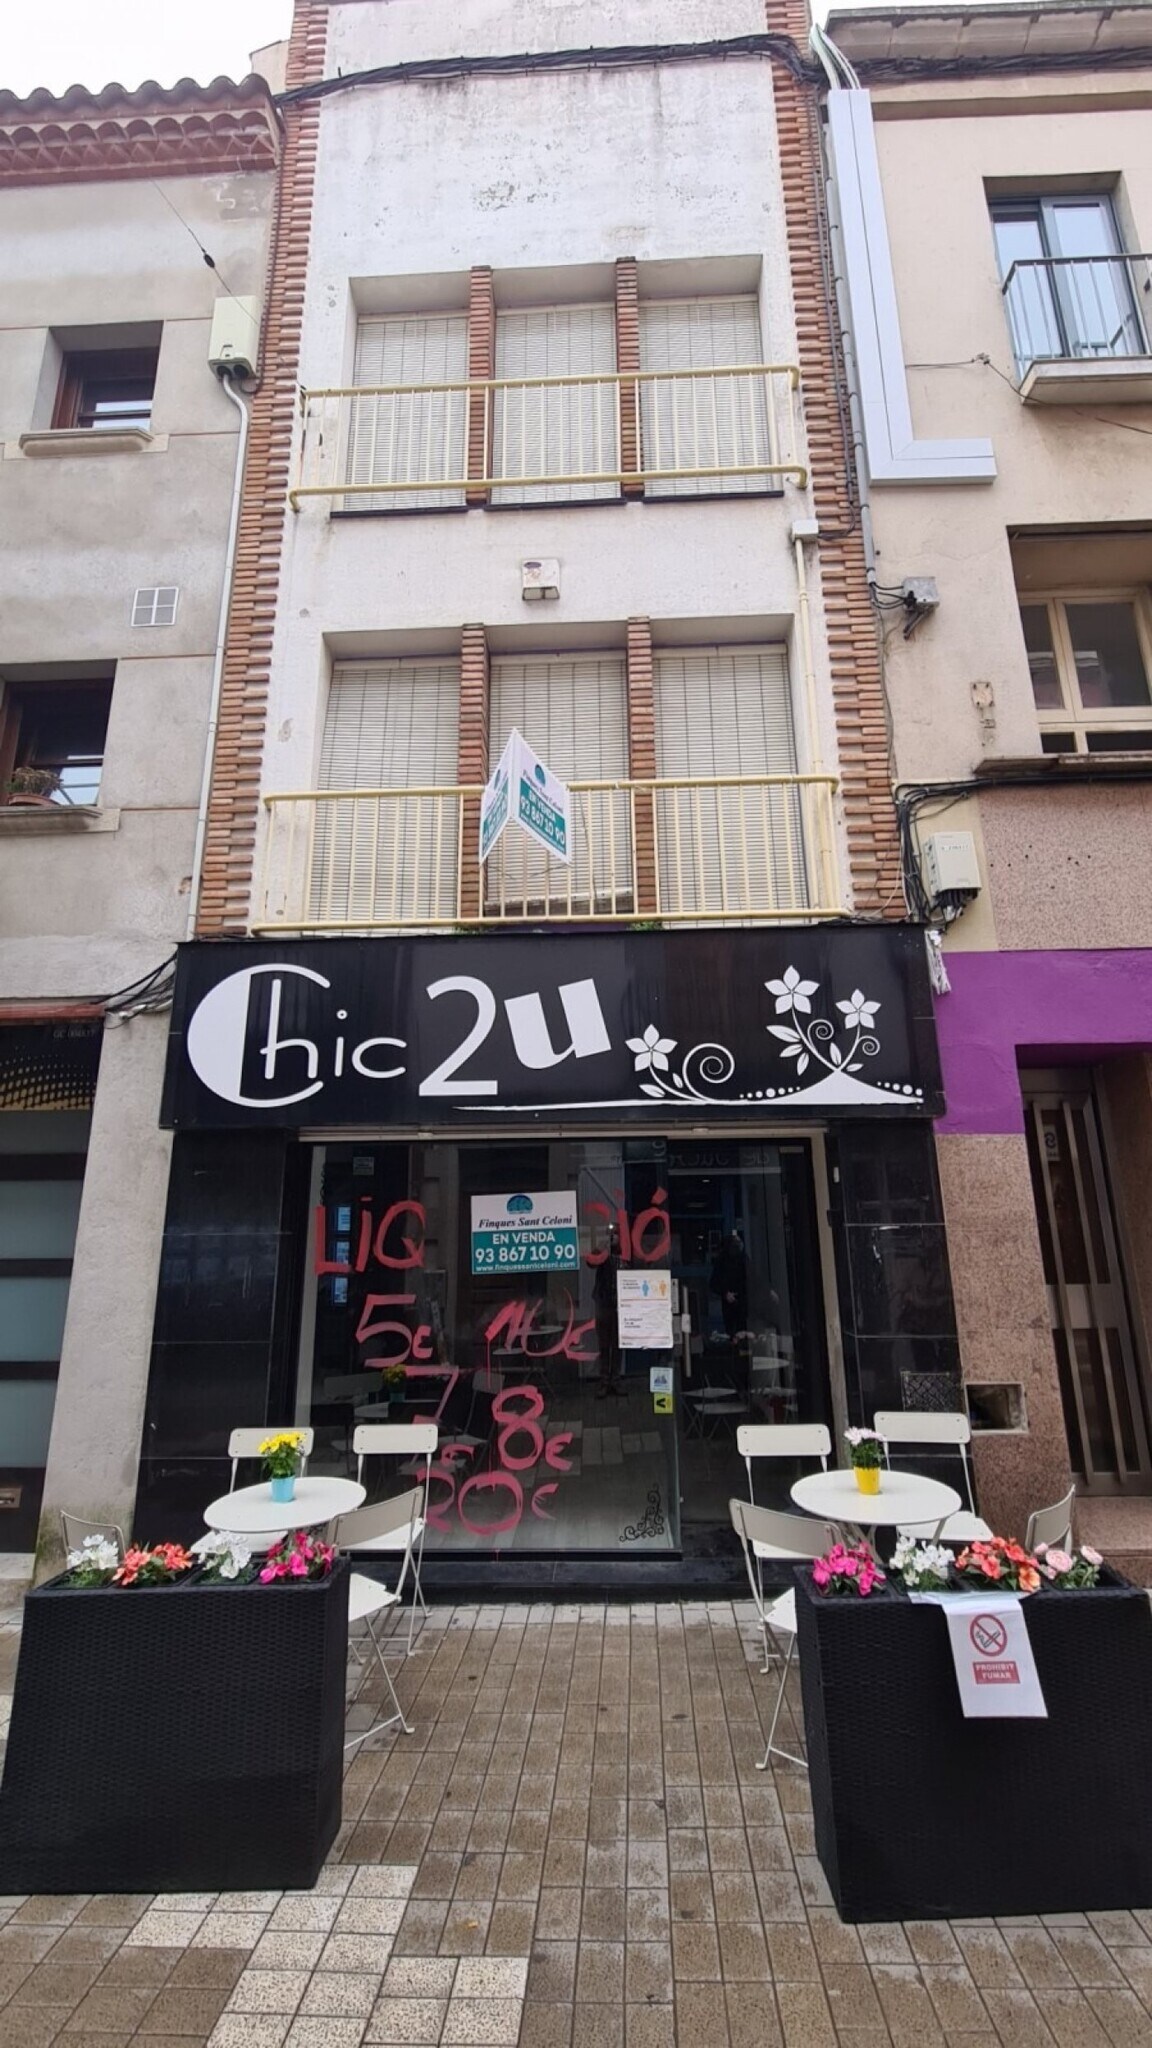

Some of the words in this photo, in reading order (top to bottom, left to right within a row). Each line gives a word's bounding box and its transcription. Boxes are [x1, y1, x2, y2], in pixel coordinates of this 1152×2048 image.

[187, 963, 407, 1107] Chic
[479, 1218, 516, 1229] Finques
[518, 1217, 540, 1226] Sant
[542, 1215, 573, 1226] Celoni
[492, 1233, 509, 1245] EN
[512, 1231, 556, 1243] VENDA
[475, 1248, 494, 1263] 93
[499, 1246, 527, 1262] 867
[530, 1245, 550, 1260] 10
[554, 1244, 576, 1259] 90
